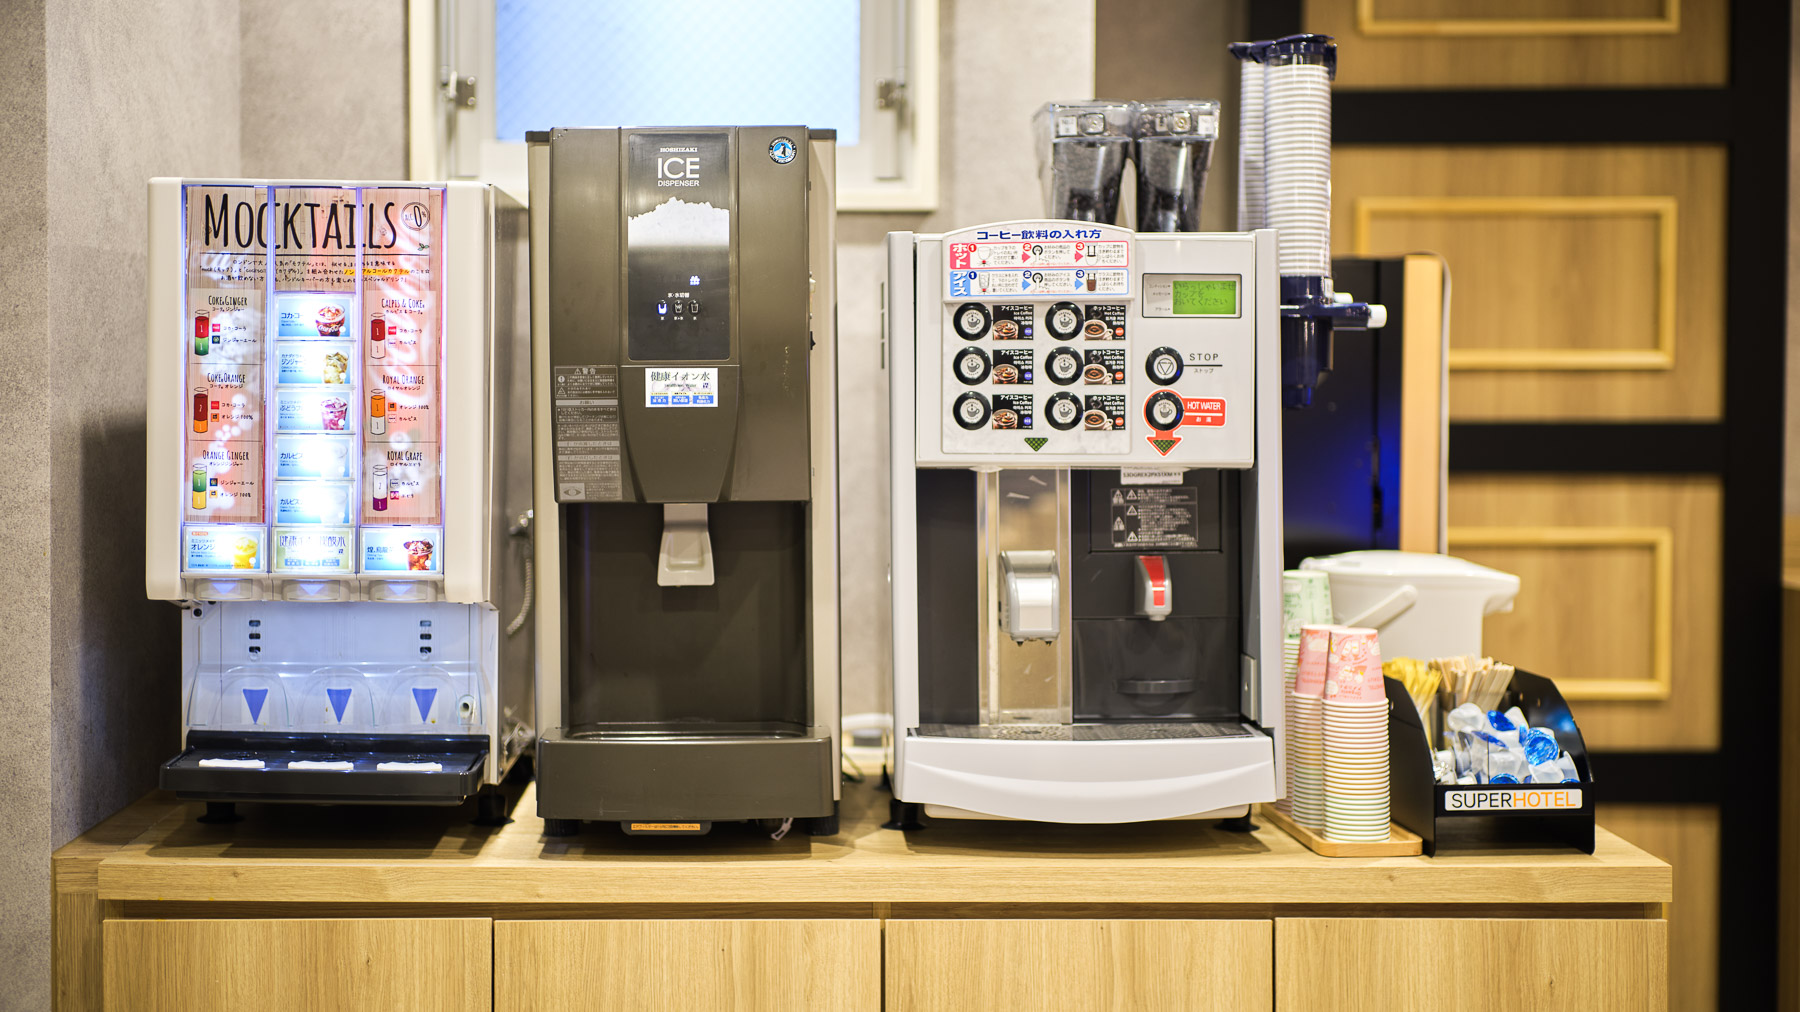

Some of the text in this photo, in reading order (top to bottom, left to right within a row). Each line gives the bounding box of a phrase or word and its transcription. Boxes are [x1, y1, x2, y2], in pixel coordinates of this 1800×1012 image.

[658, 157, 700, 179] ICE
[205, 193, 396, 250] MOCKTAILS
[977, 229, 1102, 240] コーヒー飲料の入れ方
[952, 244, 968, 268] ホット
[952, 272, 968, 296] アイス
[381, 298, 400, 308] CALPIS
[382, 375, 424, 384] ROYAL ORANGE
[650, 371, 710, 381] 健康イオン水
[1200, 402, 1221, 410] WATER
[203, 450, 249, 461] ORANGE GINGER
[387, 450, 422, 461] ROYAL GRAPE
